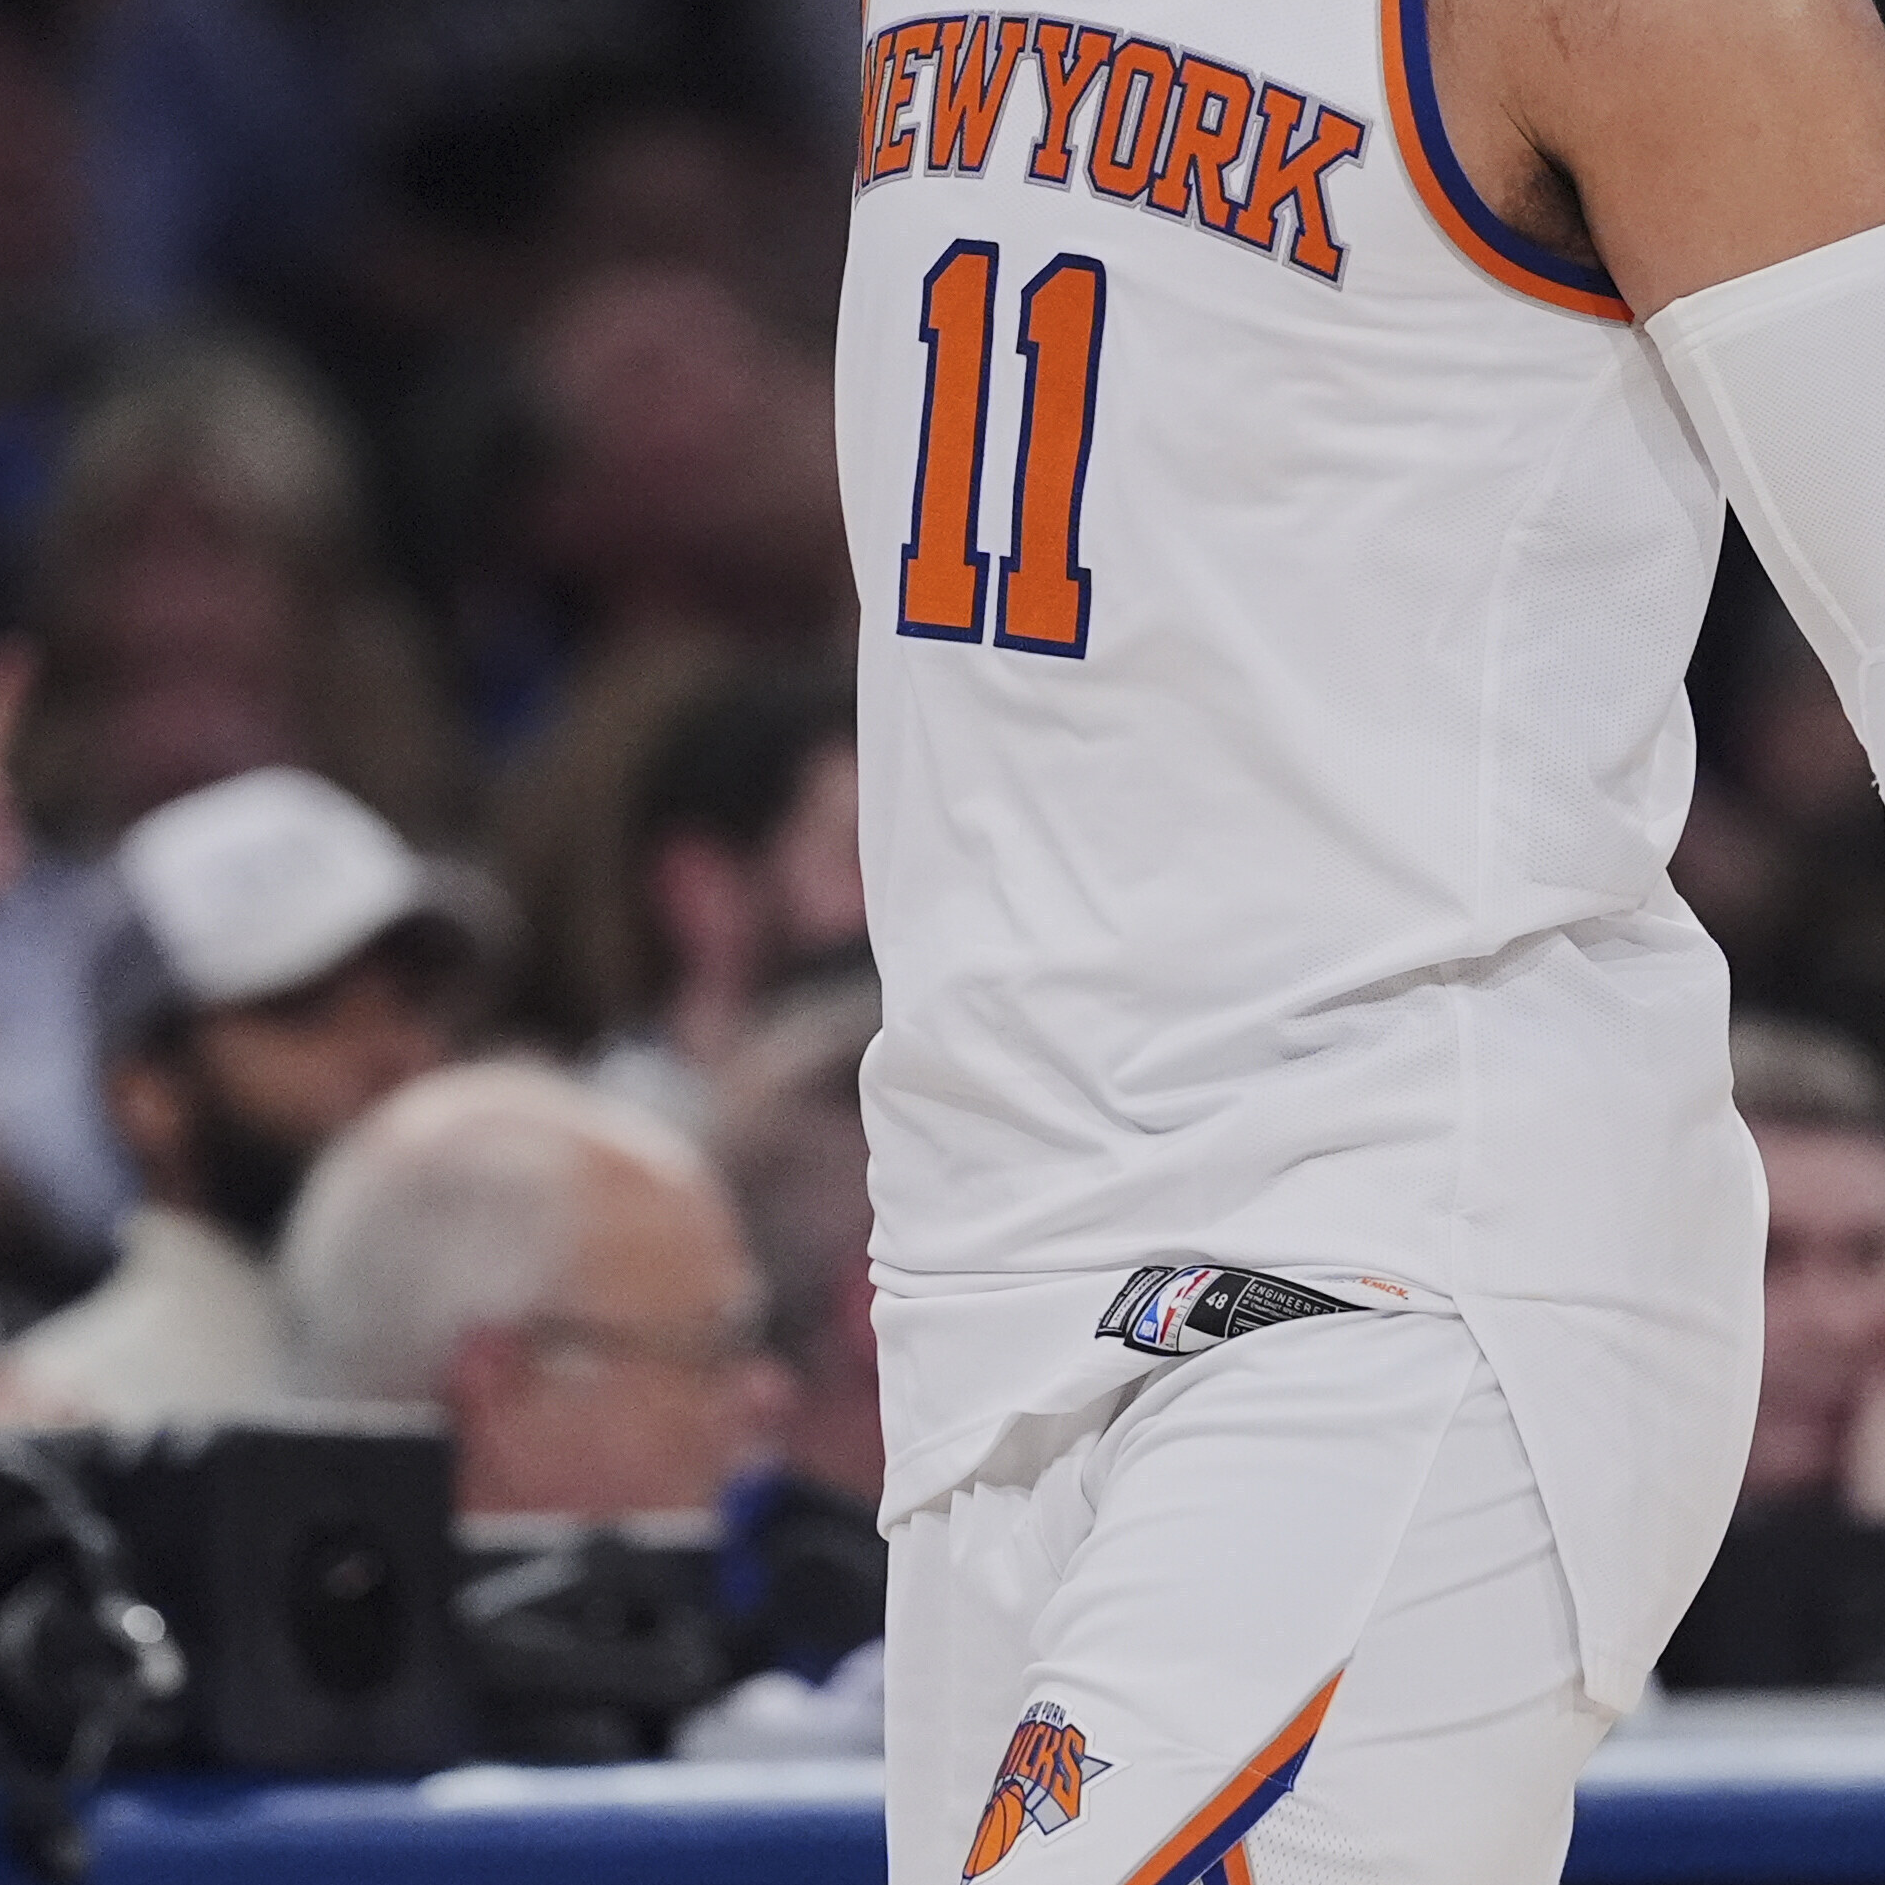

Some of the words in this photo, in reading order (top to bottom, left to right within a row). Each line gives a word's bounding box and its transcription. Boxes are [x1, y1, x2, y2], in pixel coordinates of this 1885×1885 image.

[1024, 11, 1373, 292] YORK
[897, 238, 1107, 659] 11
[1205, 1290, 1229, 1310] 48
